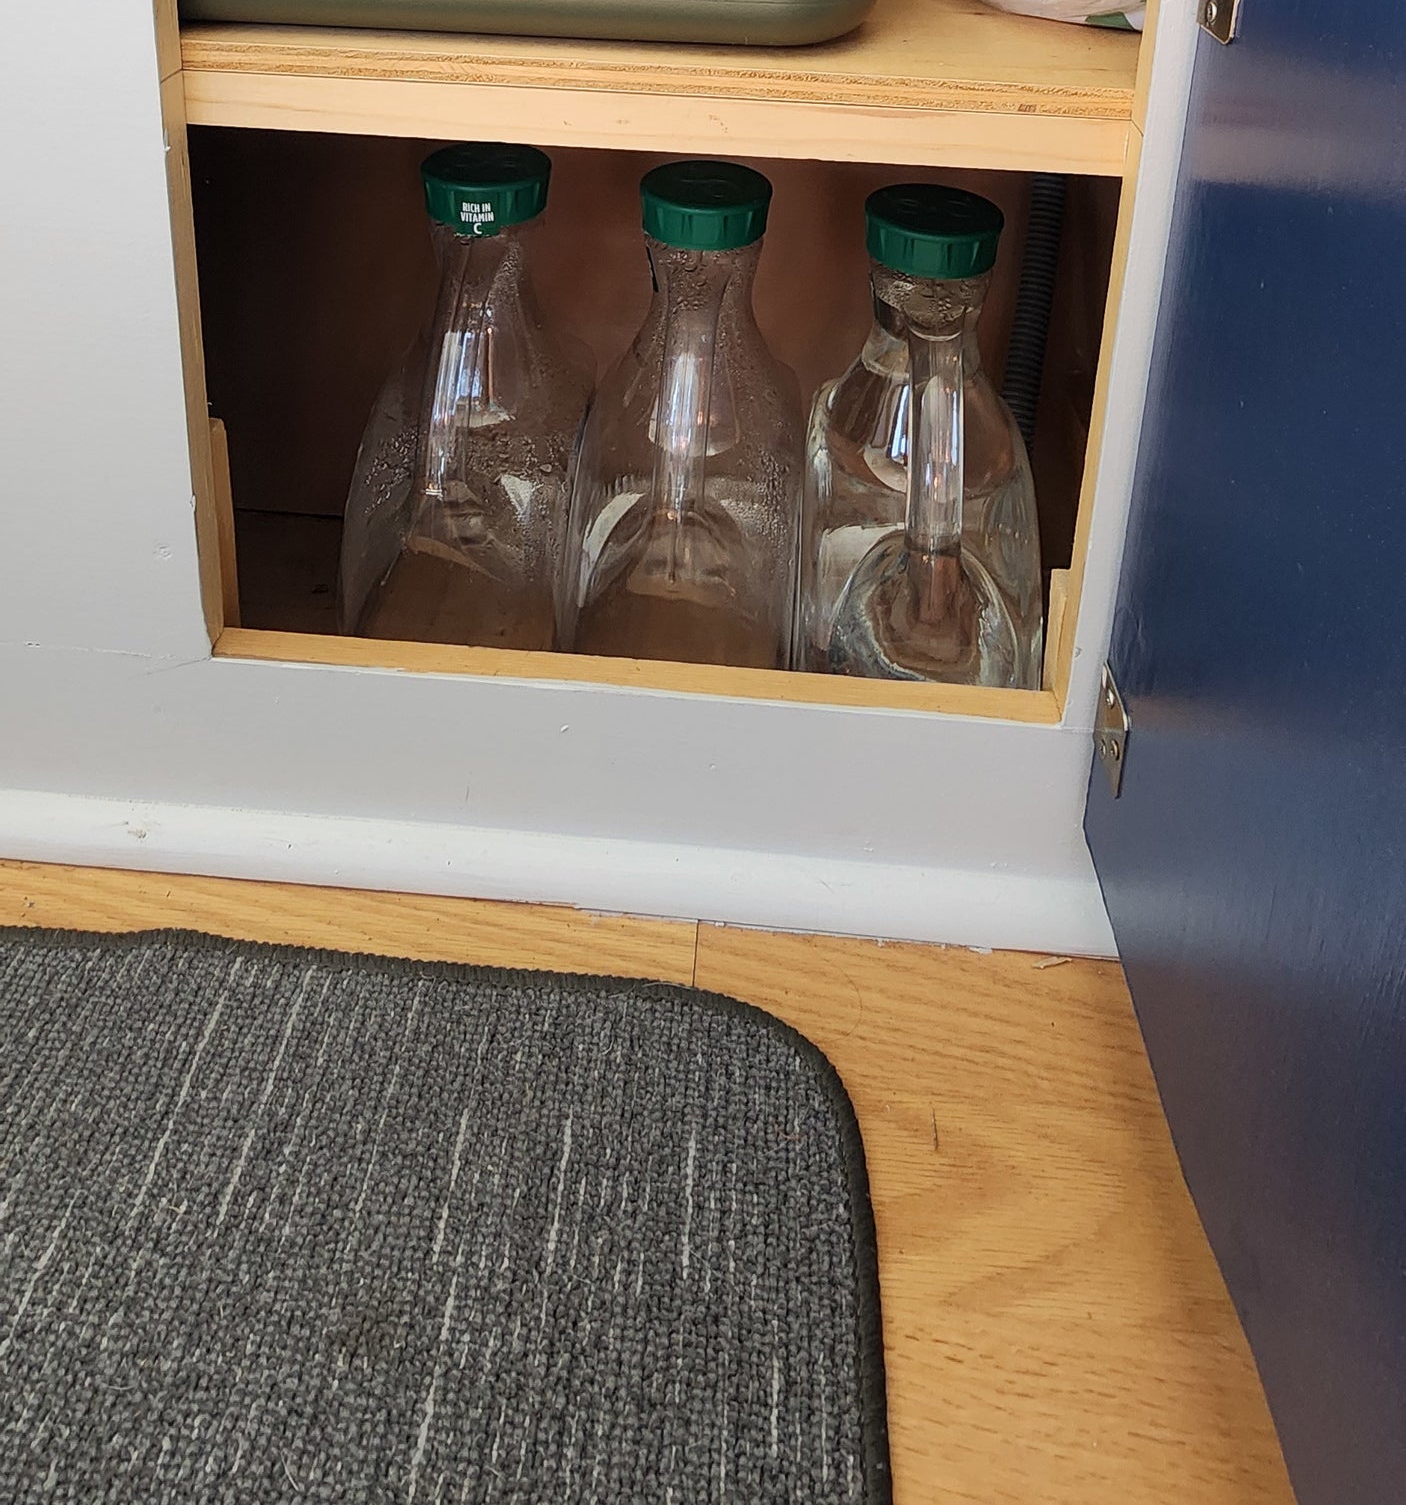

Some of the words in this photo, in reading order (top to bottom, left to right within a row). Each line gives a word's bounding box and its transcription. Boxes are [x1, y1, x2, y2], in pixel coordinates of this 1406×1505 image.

[462, 202, 480, 213] RICH
[481, 202, 491, 212] IN
[460, 211, 494, 222] VITAMIN
[473, 222, 483, 234] C
